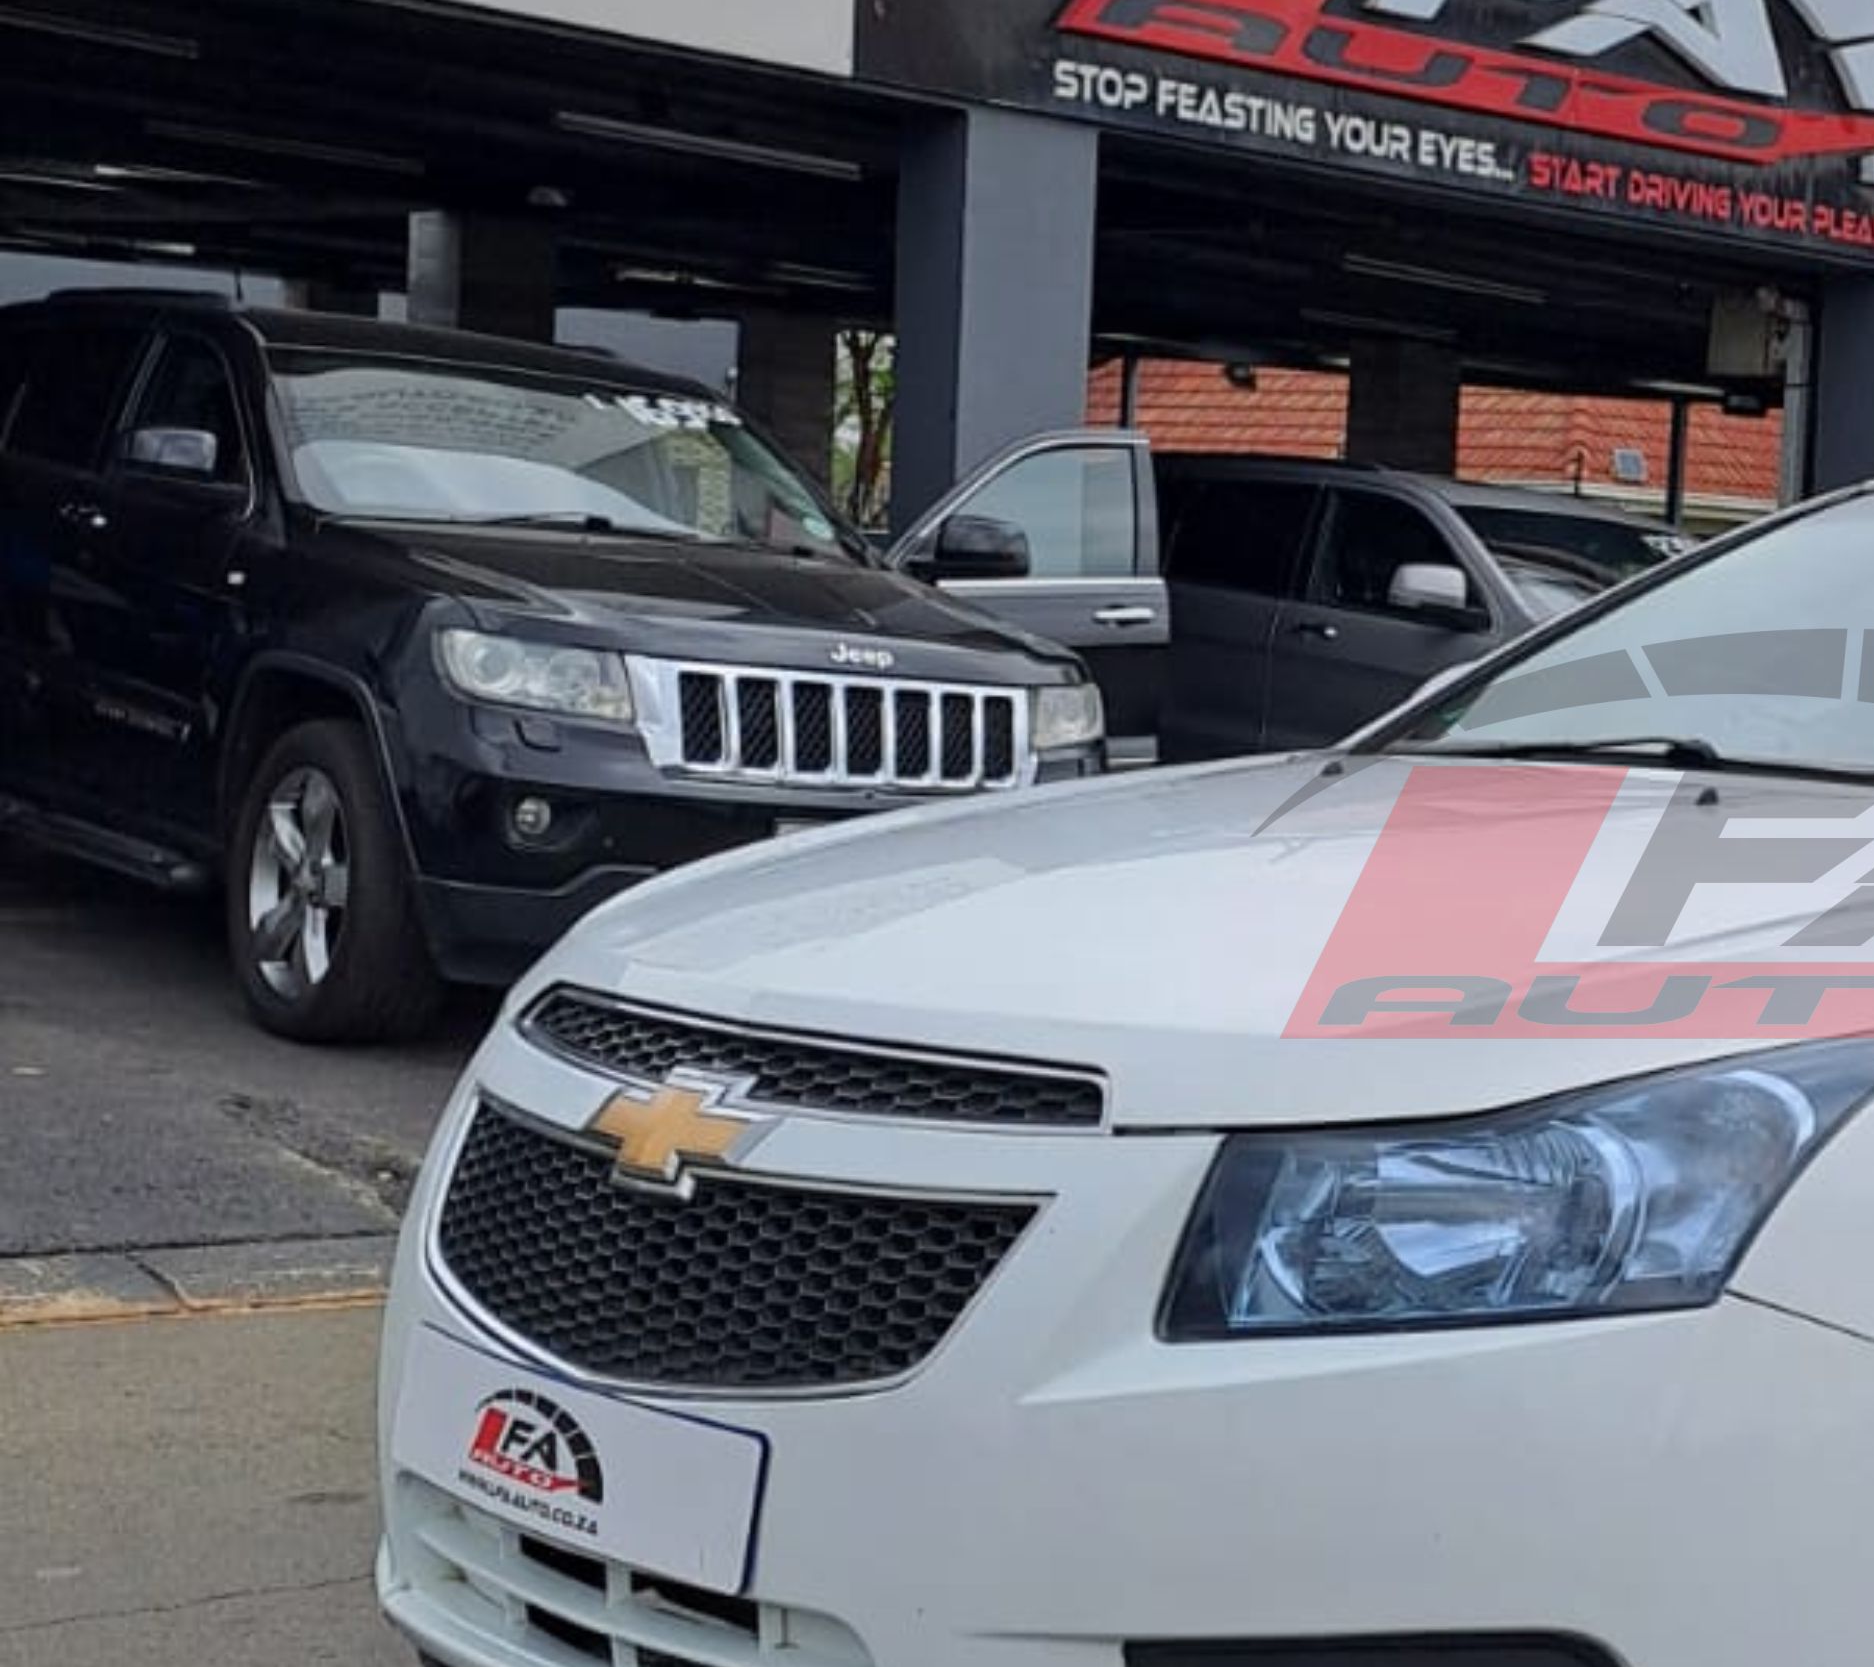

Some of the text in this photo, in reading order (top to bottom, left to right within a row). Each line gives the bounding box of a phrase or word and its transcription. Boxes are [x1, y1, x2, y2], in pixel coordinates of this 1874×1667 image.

[1053, 60, 1148, 110] STOP
[1156, 78, 1317, 144] FEASTING
[1323, 110, 1411, 164] YOUR
[1528, 151, 1621, 200] START
[1627, 169, 1733, 220] DRIVING
[1738, 191, 1805, 232] YOUR
[830, 642, 895, 670] Jeep
[471, 1406, 558, 1473] LFA
